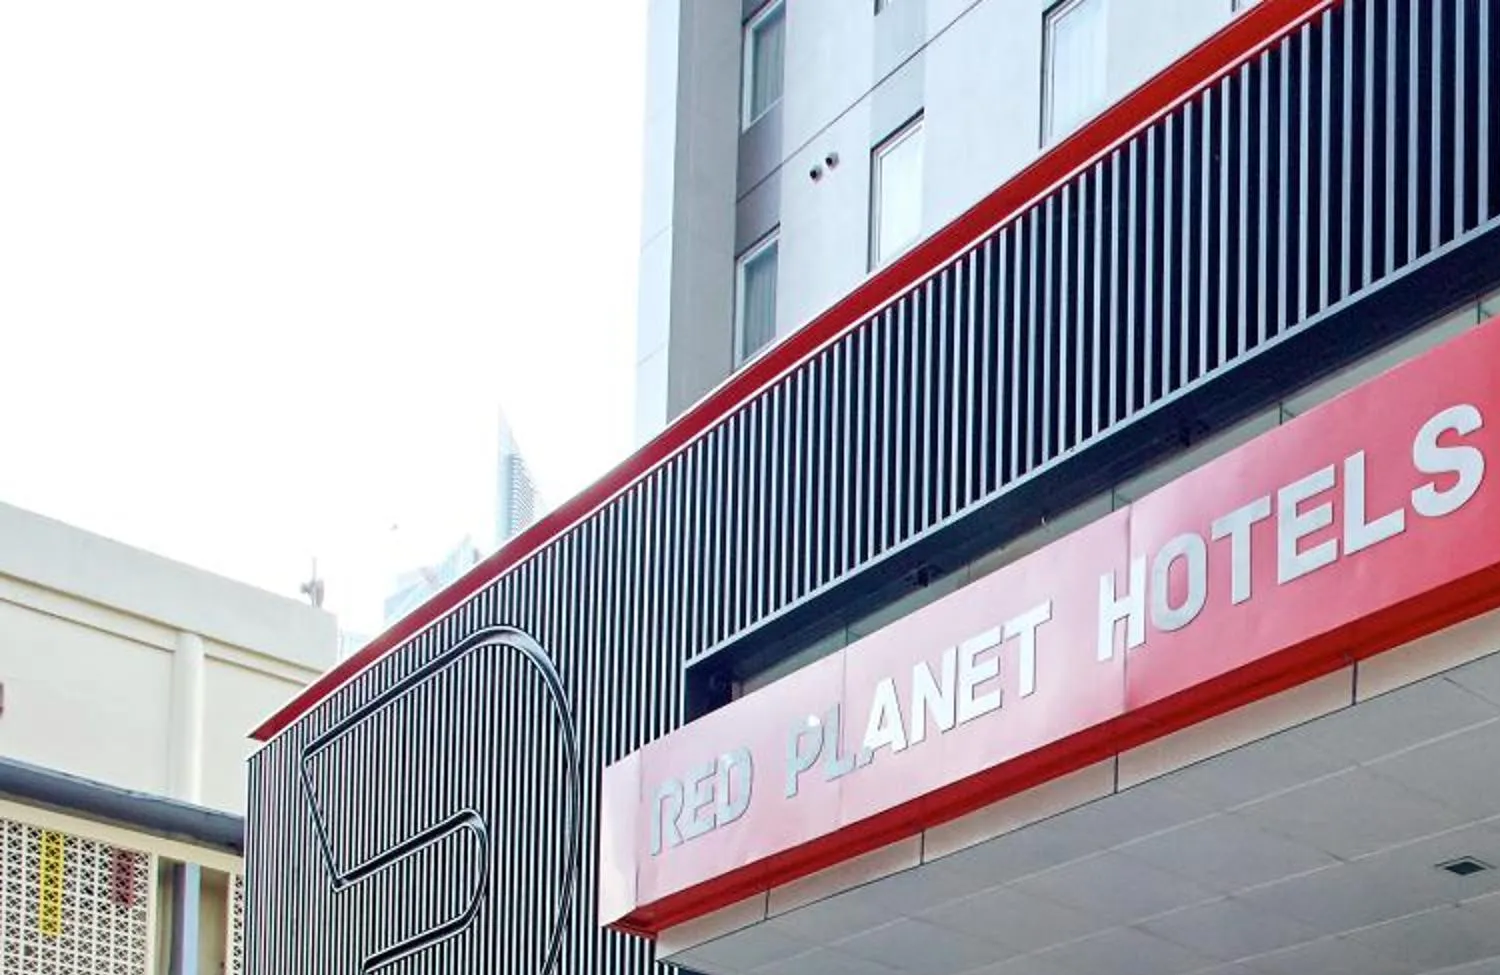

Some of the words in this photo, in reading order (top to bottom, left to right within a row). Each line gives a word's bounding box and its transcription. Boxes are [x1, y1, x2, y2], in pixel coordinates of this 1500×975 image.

[649, 744, 755, 857] RED
[785, 600, 1053, 799] PLANET
[1097, 402, 1487, 663] HOTELS
